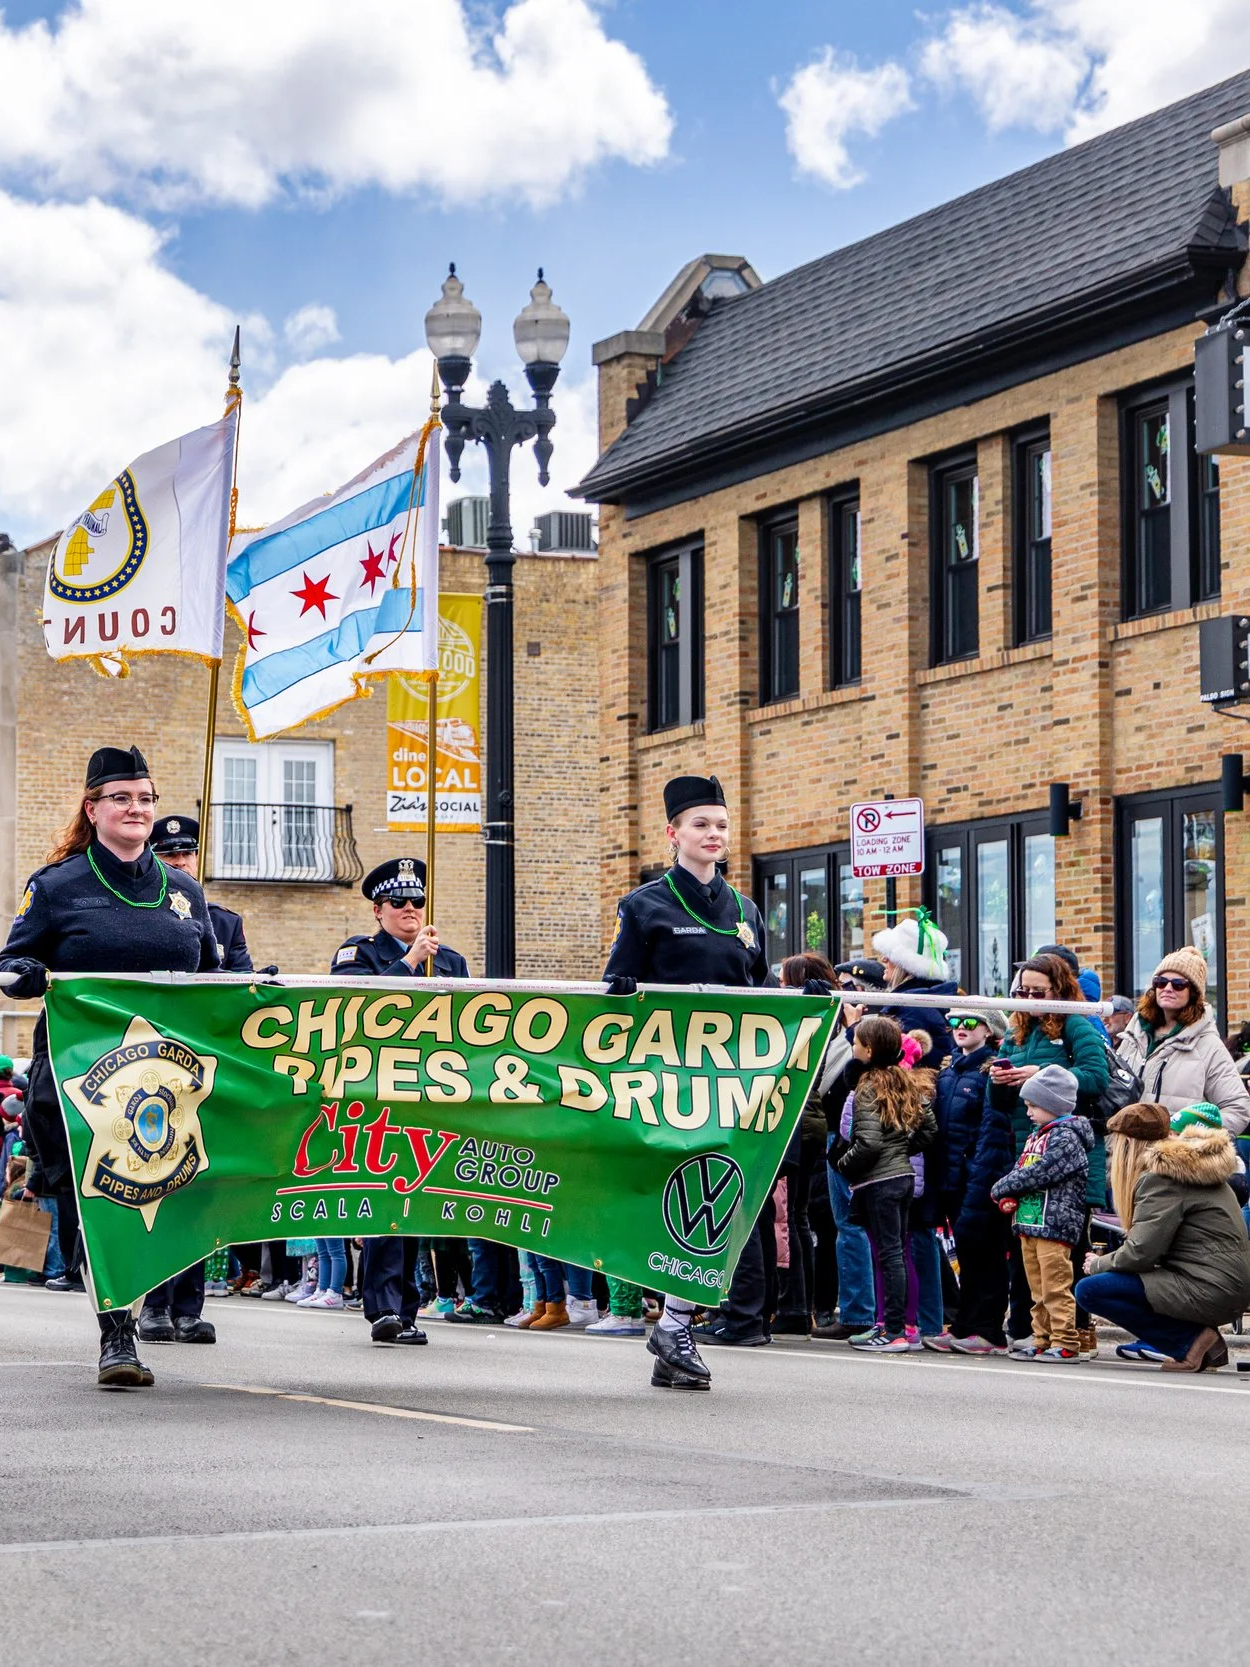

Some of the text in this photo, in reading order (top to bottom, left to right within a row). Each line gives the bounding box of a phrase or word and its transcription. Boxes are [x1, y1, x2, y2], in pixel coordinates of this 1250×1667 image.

[393, 747, 426, 762] dine
[390, 795, 427, 812] Zia's
[856, 835, 911, 847] LOADING ZONE
[857, 848, 864, 856] 10
[866, 847, 877, 855] AM
[883, 846, 890, 854] 12
[892, 845, 903, 853] AM
[858, 863, 917, 876] TOW ZONE
[240, 992, 822, 1071] CHICAGO GARDA
[85, 1044, 200, 1092] CHICAGO GARDA
[273, 1045, 791, 1133] PIPES & DRUMS
[291, 1101, 460, 1193] City
[458, 1137, 535, 1165] AUTO
[99, 1155, 197, 1201] PIPES AND DRUMS
[455, 1158, 560, 1195] GROUP
[271, 1198, 372, 1222] SCALA
[441, 1201, 551, 1238] KOHLI
